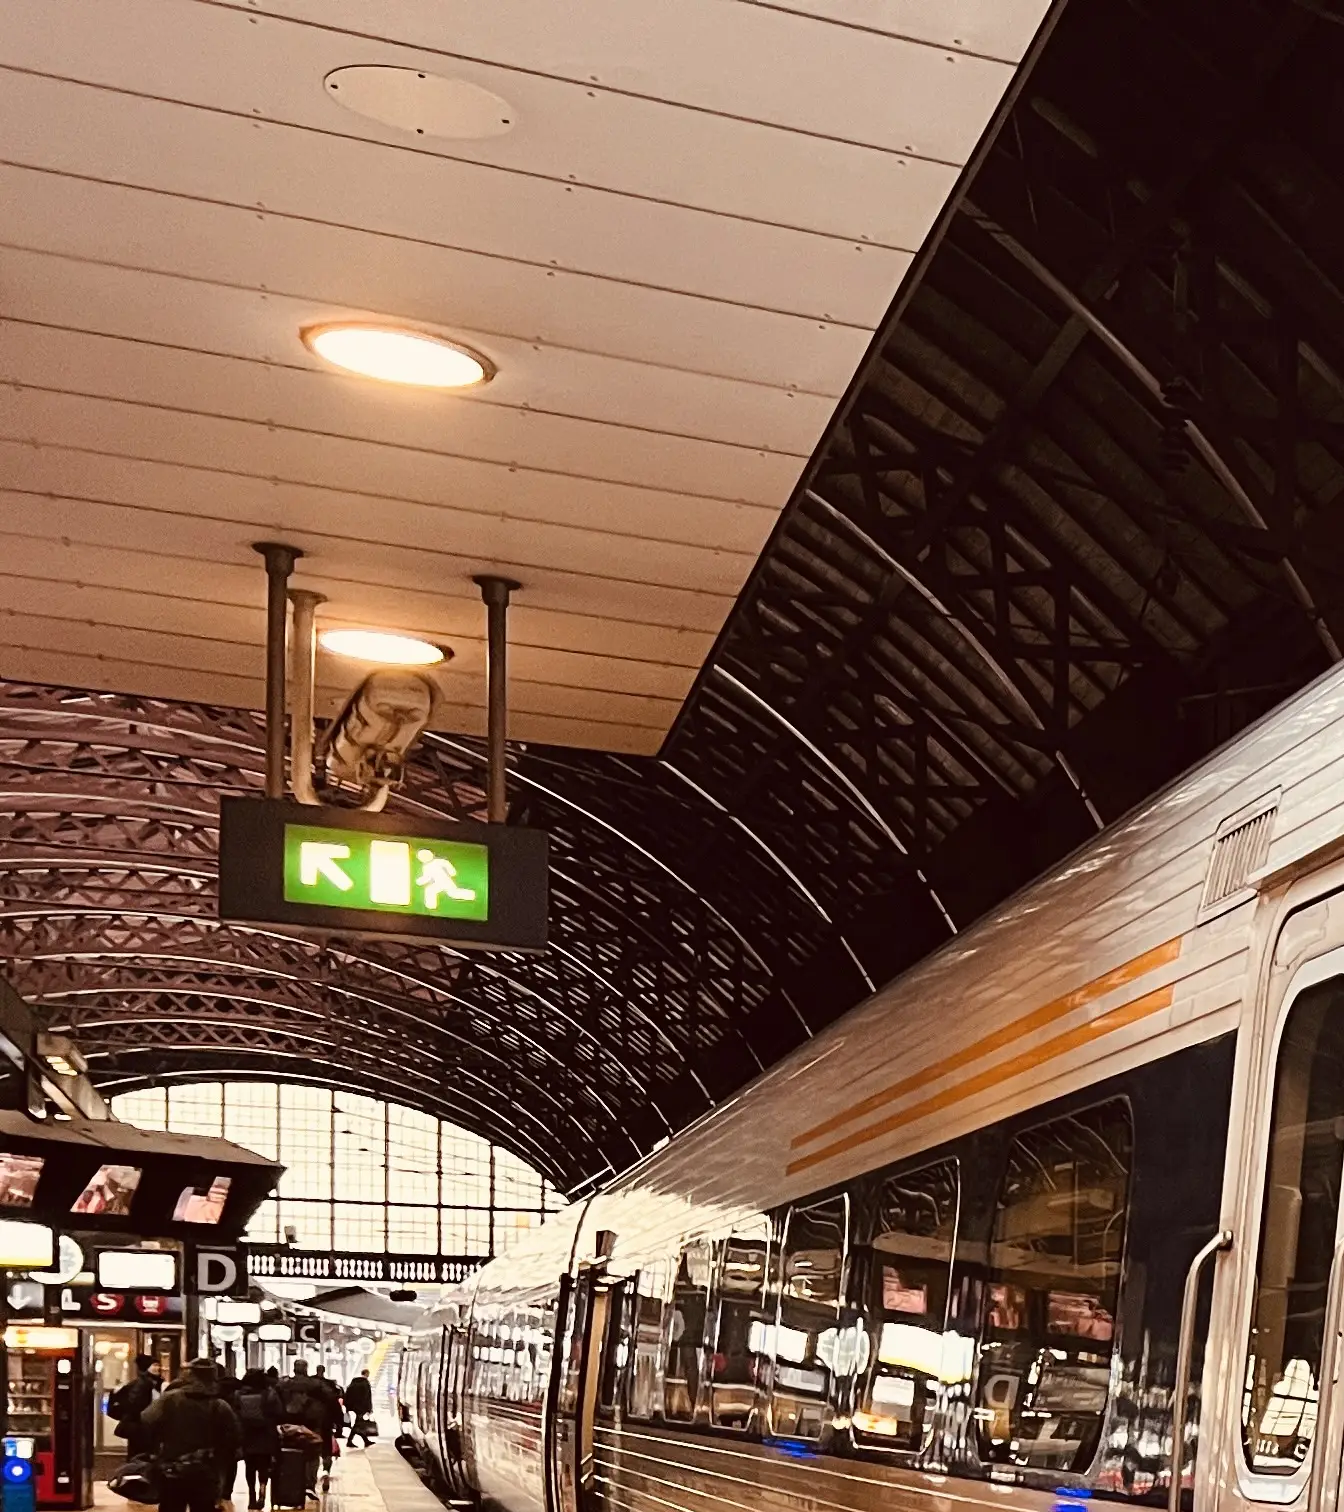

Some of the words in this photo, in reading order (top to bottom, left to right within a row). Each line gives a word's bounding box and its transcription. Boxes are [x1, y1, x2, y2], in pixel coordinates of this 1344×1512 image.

[197, 1252, 236, 1292] D
[96, 1293, 117, 1310] S
[300, 1325, 316, 1342] C
